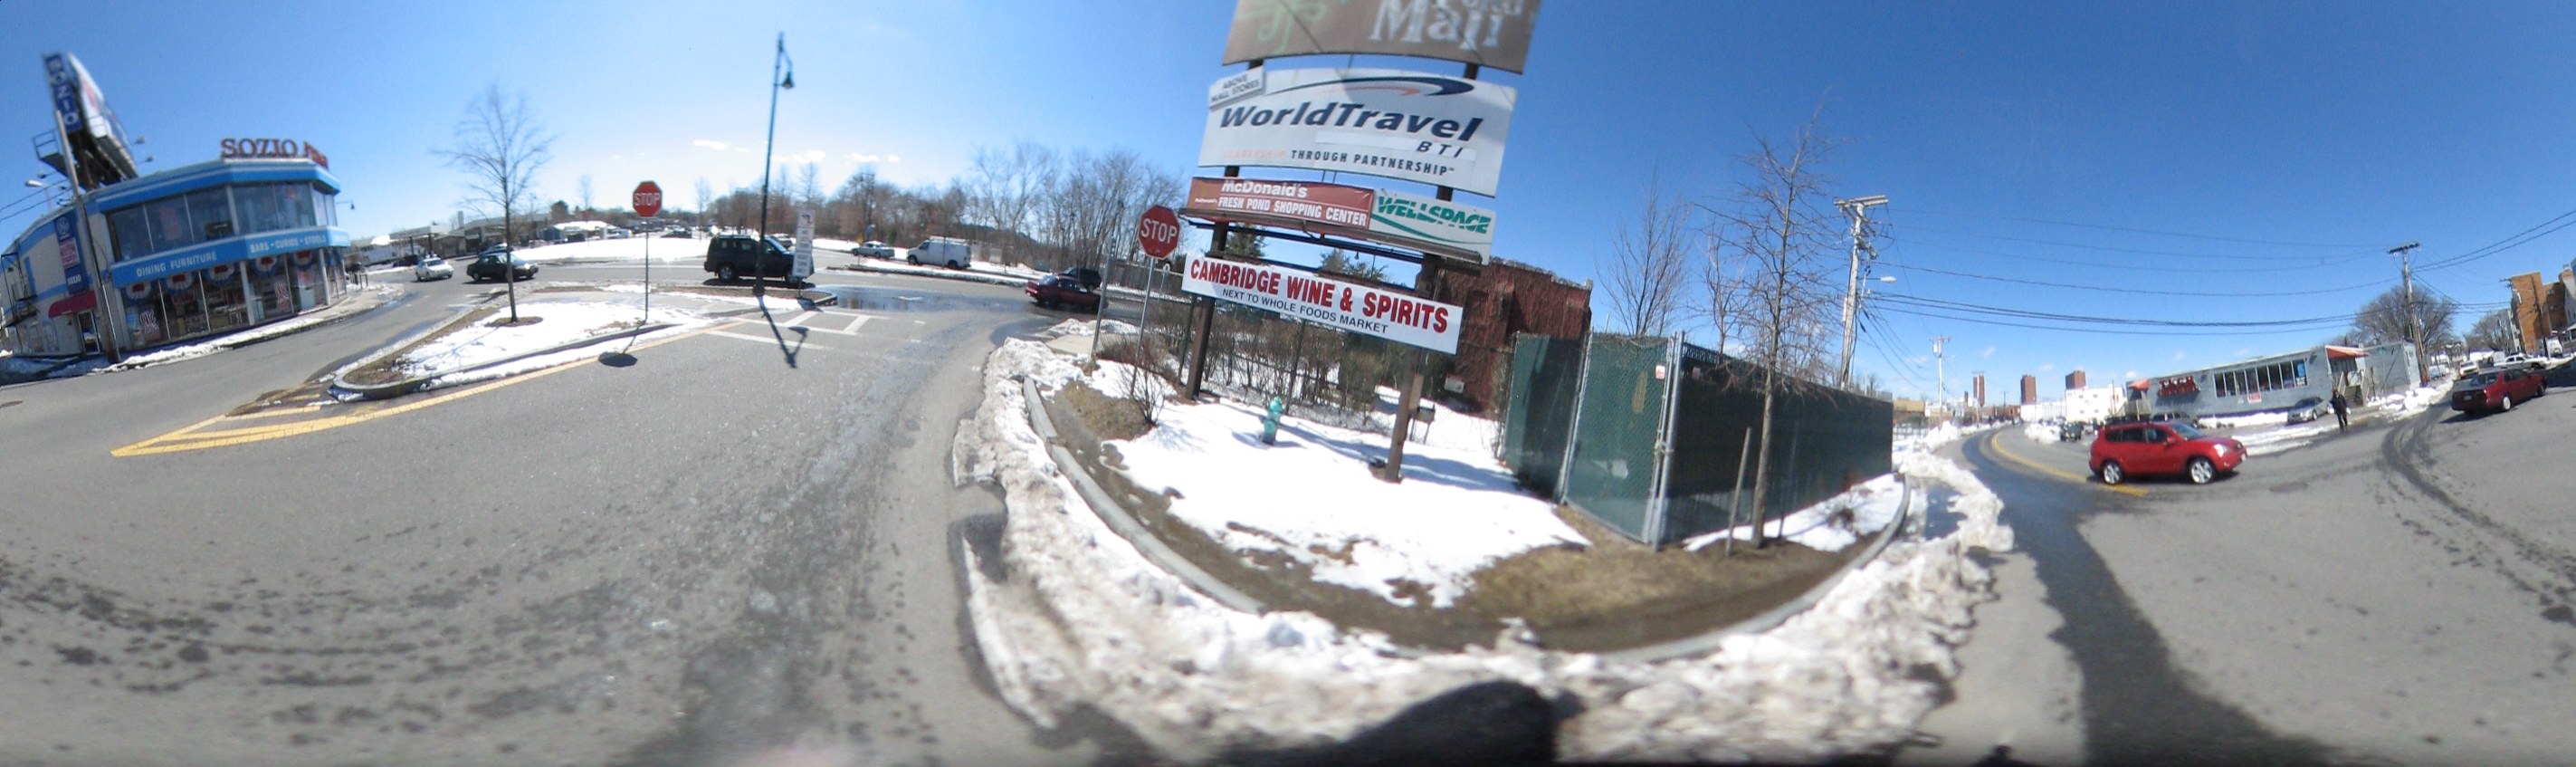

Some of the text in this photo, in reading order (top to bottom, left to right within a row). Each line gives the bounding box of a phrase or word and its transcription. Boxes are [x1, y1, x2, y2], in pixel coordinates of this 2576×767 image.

[1221, 101, 1483, 142] WorldTravel
[221, 138, 297, 158] SOZIO
[1291, 149, 1348, 163] THROUGH
[634, 193, 660, 206] STOP
[1217, 196, 1368, 226] FRESH POND SHOPPING CENTER
[1379, 196, 1491, 235] WELLSPACE
[1140, 217, 1178, 244] STOP
[250, 242, 269, 253] BARS
[136, 252, 217, 277] DINING FURNITURE
[1190, 259, 1449, 333] CAMBRIDGE WINE & SPIRITS
[1222, 288, 1388, 333] NEXT TO WHOLE FOODS MARKET
